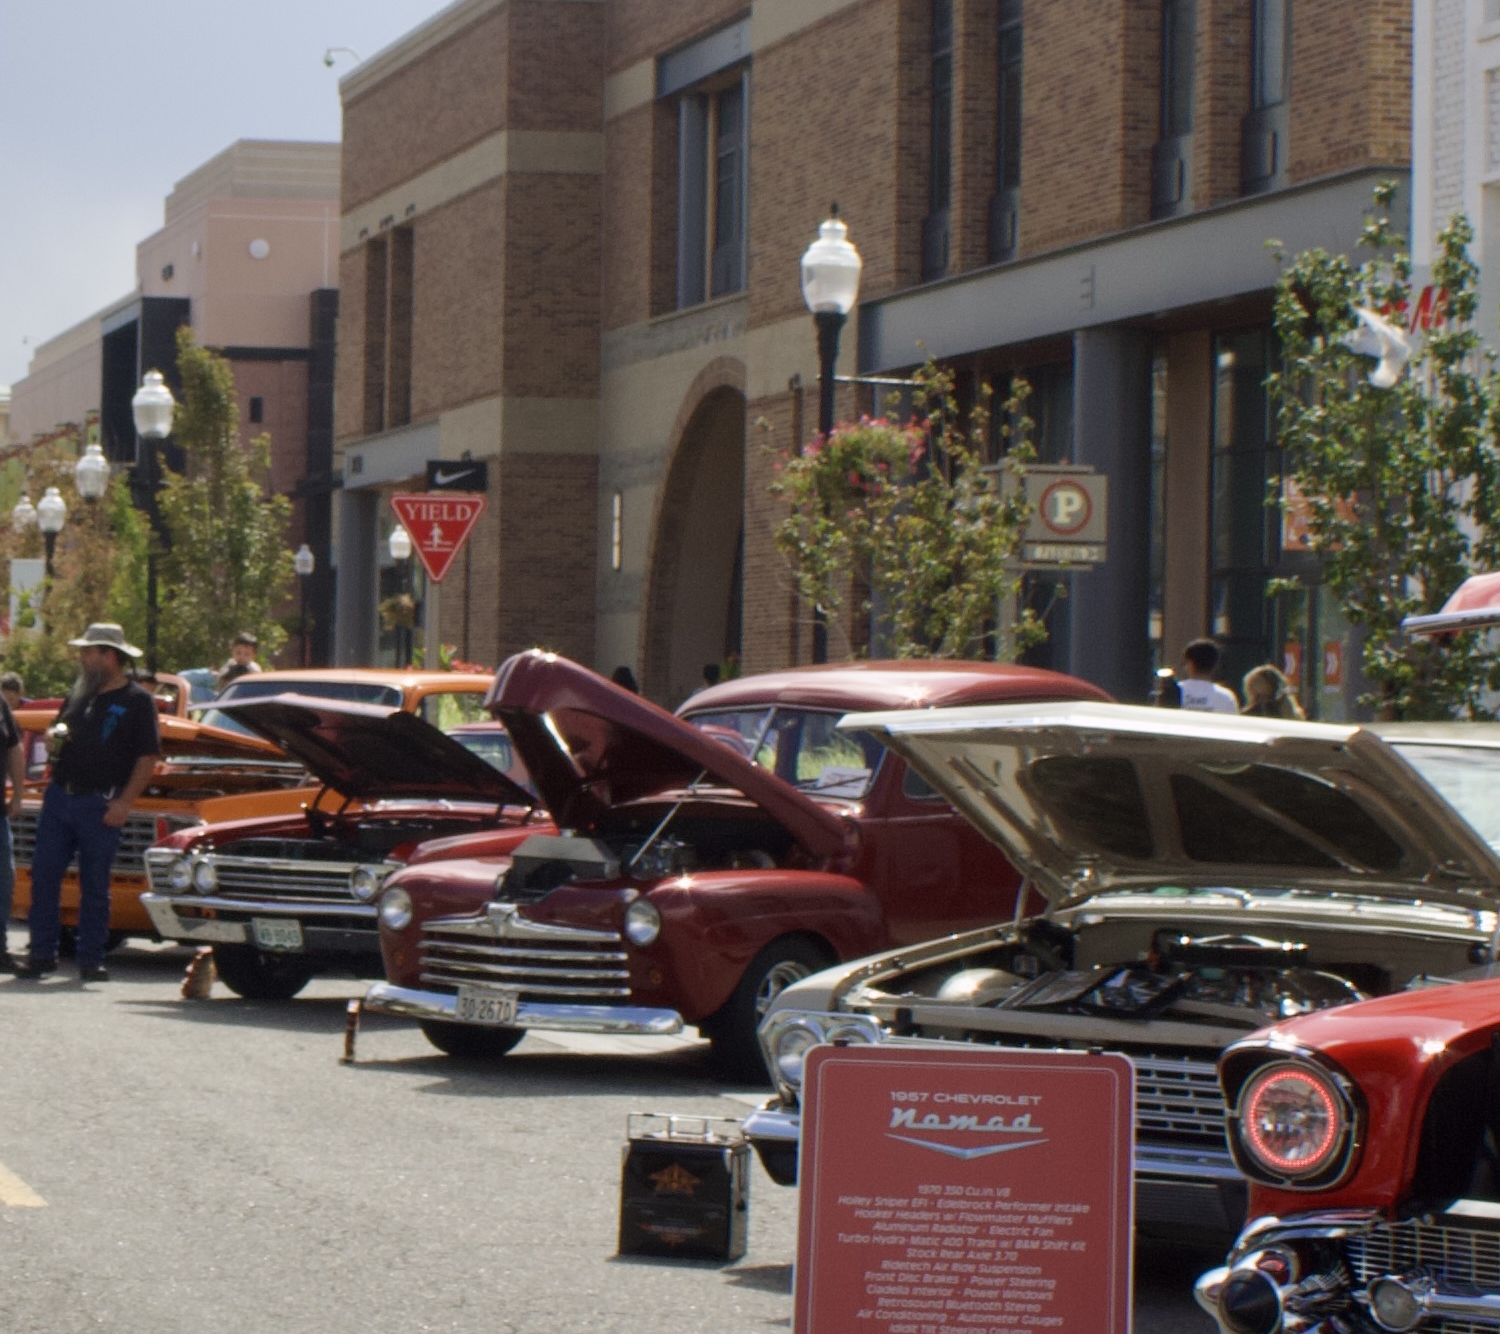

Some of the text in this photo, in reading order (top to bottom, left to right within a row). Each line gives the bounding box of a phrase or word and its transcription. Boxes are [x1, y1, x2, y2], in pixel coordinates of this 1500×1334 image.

[405, 502, 473, 522] YIELD
[890, 1091, 1042, 1105] 1957 CHEVROLET
[889, 1107, 1043, 1133] Nomad
[936, 1199, 992, 1209] Edelbrock
[994, 1201, 1052, 1212] Performer
[872, 1221, 930, 1231] Aluminum
[838, 1233, 871, 1243] Turbo
[978, 1264, 1042, 1275] Suspension
[864, 1271, 896, 1281] Front
[970, 1276, 1007, 1286] Power
[1008, 1277, 1057, 1289] Steering
[962, 1287, 1000, 1298] Power
[1002, 1290, 1054, 1301] Windows
[945, 1300, 1002, 1311] Bluetooth
[1004, 1301, 1042, 1312] Stereo
[874, 1310, 948, 1323] Conditioning
